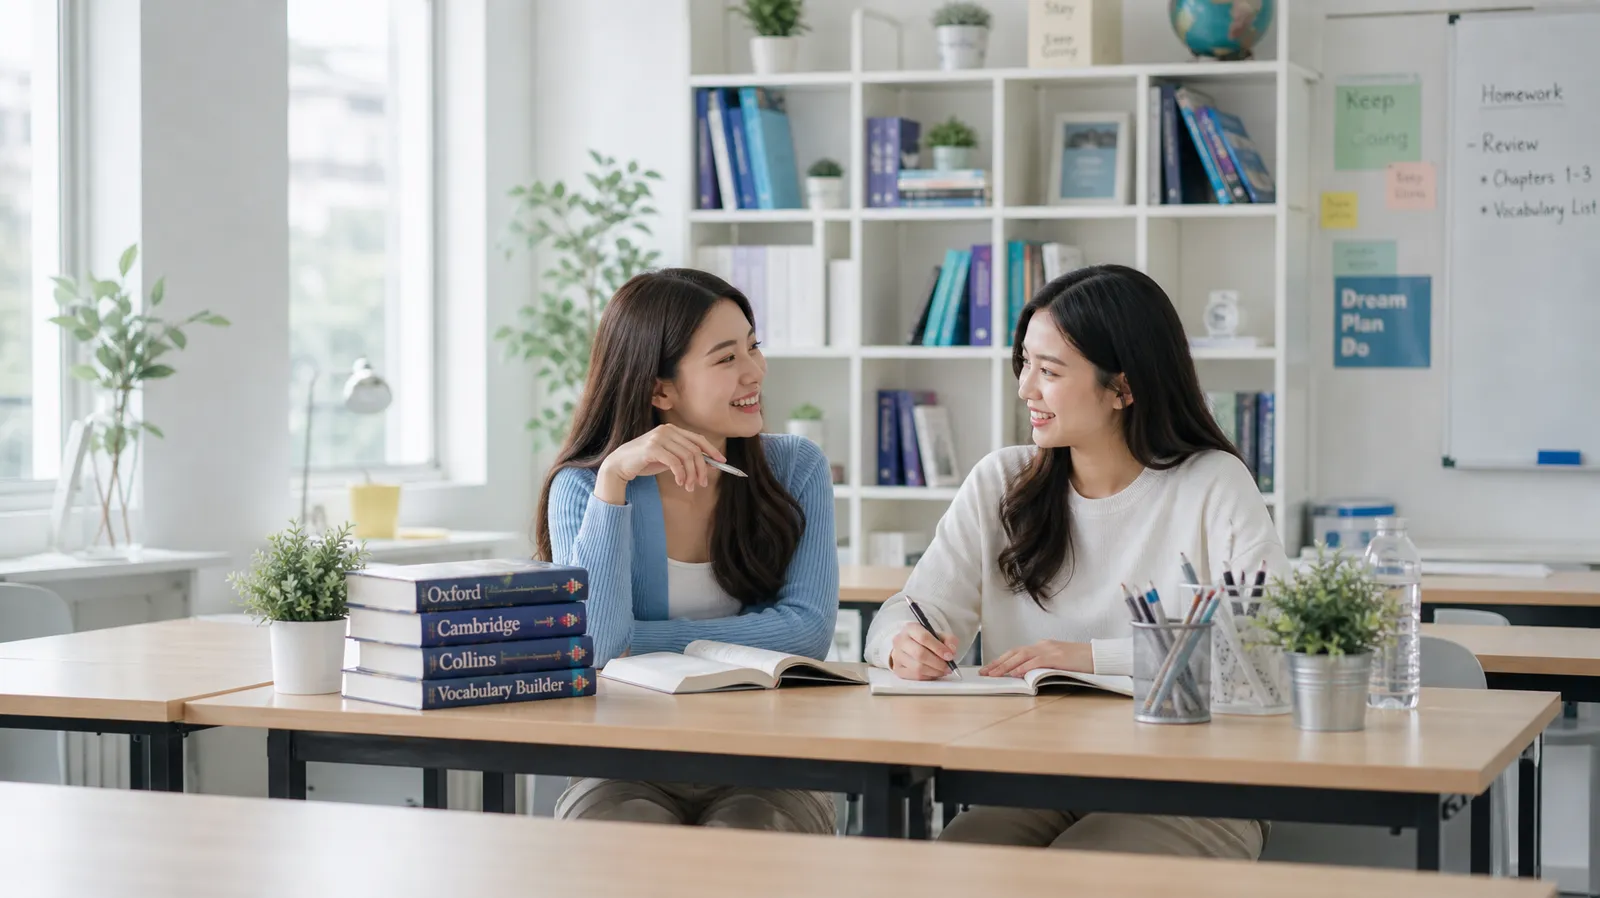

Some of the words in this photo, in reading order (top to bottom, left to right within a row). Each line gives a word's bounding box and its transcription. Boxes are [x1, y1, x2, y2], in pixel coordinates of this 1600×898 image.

[1345, 88, 1395, 115] Keep
[1481, 82, 1563, 104] Homework
[1482, 131, 1539, 153] Review
[1493, 168, 1554, 192] Chapters
[1566, 164, 1592, 184] 1-3
[1493, 199, 1564, 225] Vocabulary
[1571, 197, 1597, 216] List
[1341, 288, 1408, 309] Dream
[1341, 312, 1385, 333] Plan
[1341, 336, 1370, 358] Do
[427, 584, 481, 603] Oxford
[437, 616, 521, 638] Cambridge
[439, 652, 497, 671] Collins
[437, 682, 514, 702] Vocabulary
[516, 678, 564, 695] Builder
